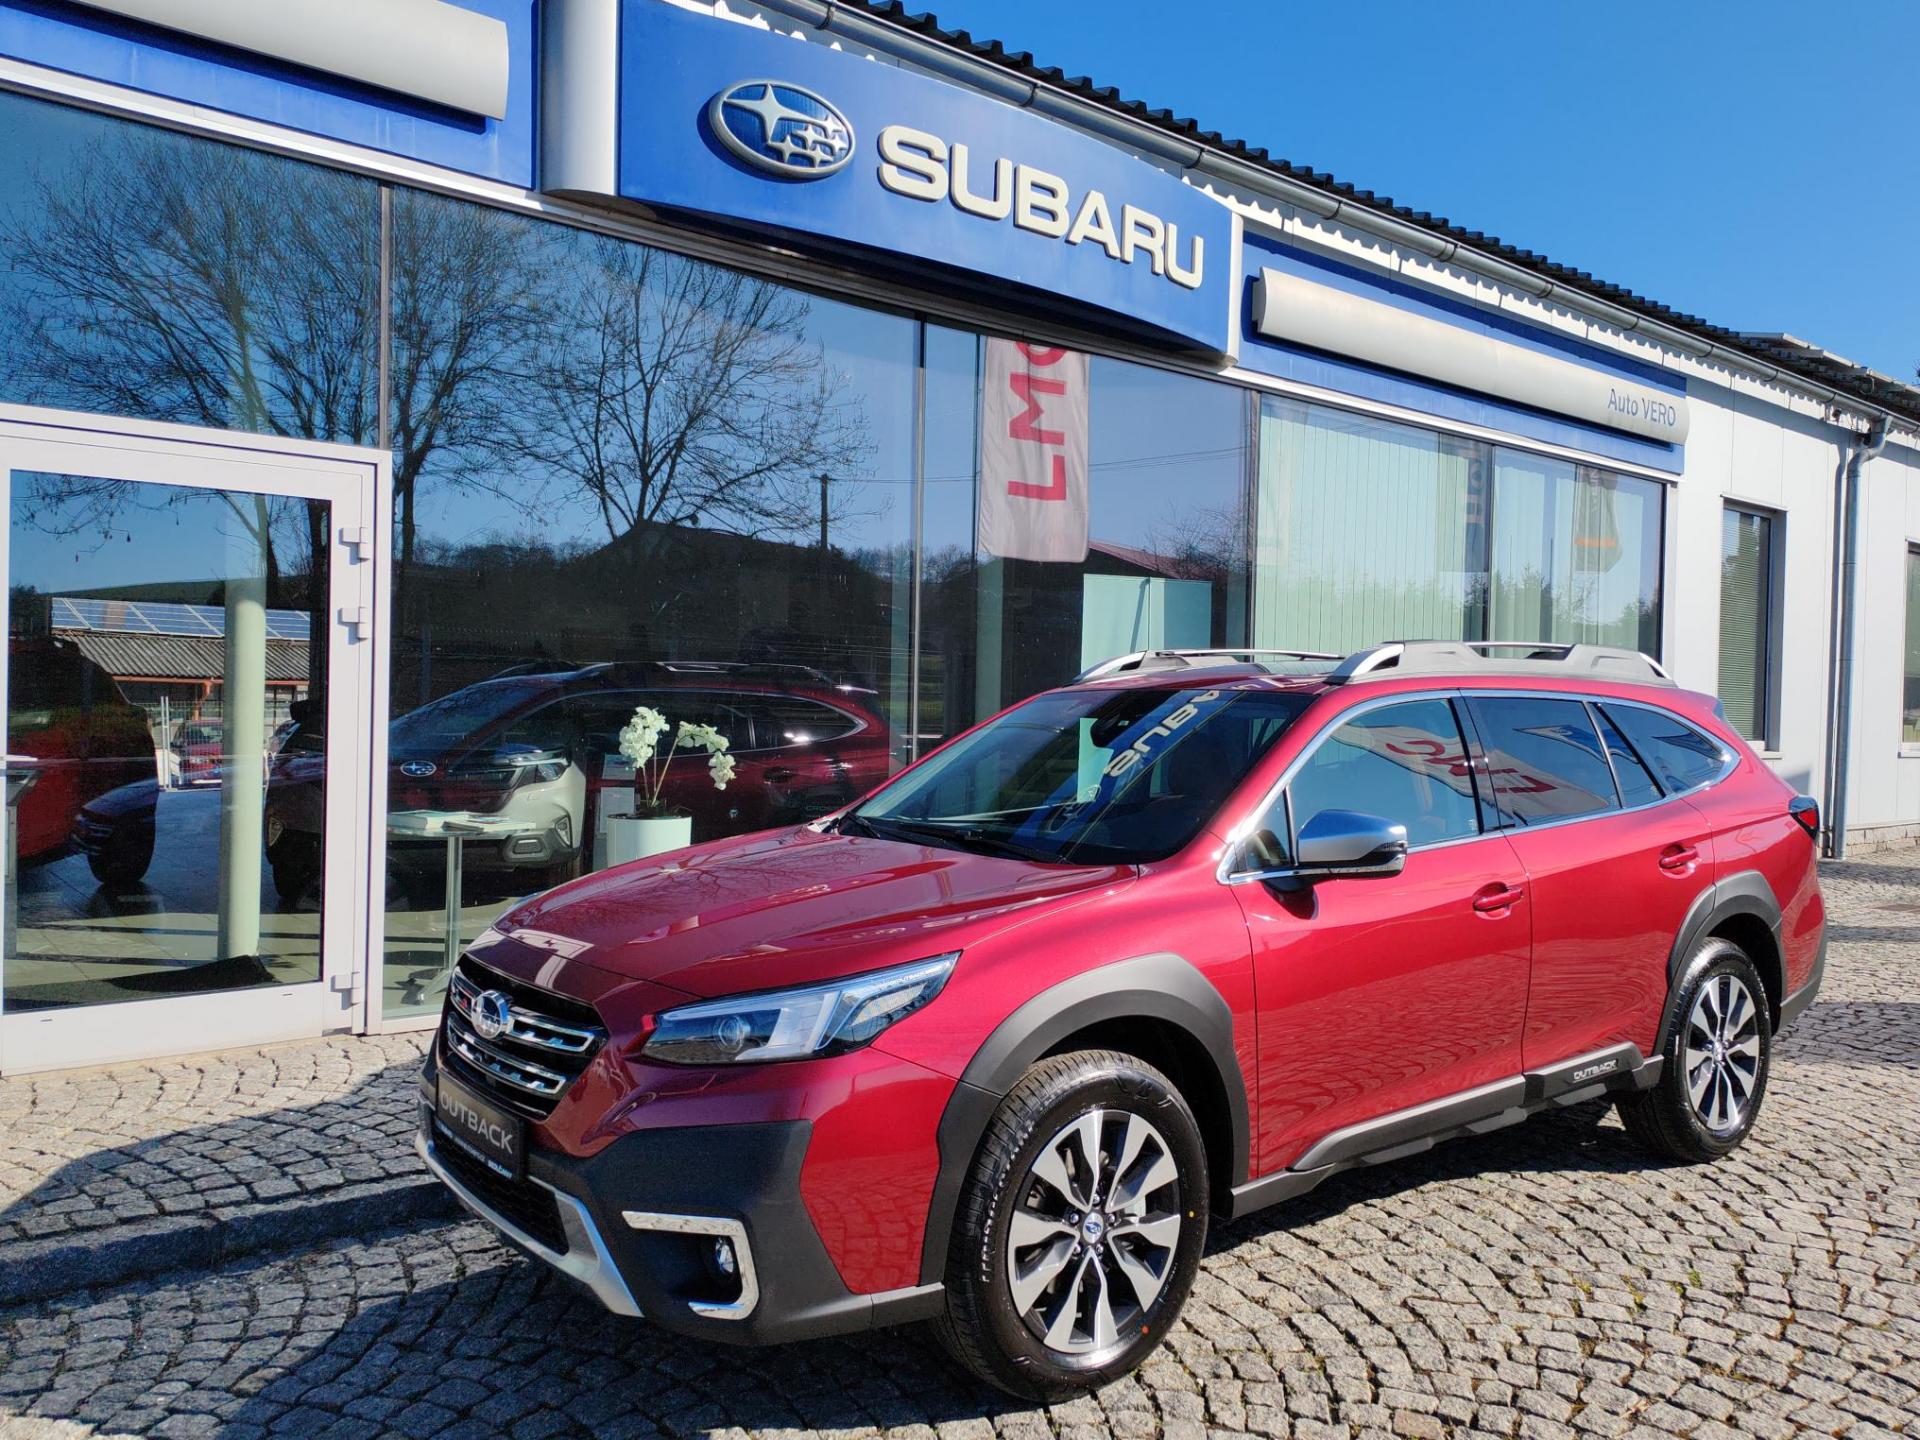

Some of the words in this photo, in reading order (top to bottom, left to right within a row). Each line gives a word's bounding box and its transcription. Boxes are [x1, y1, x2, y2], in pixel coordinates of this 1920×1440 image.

[877, 125, 1205, 290] SUBARU
[1607, 388, 1639, 417] Auto
[1641, 397, 1676, 427] VERO
[1573, 1060, 1617, 1080] OUTBACK
[441, 1091, 513, 1154] OUTBACK
